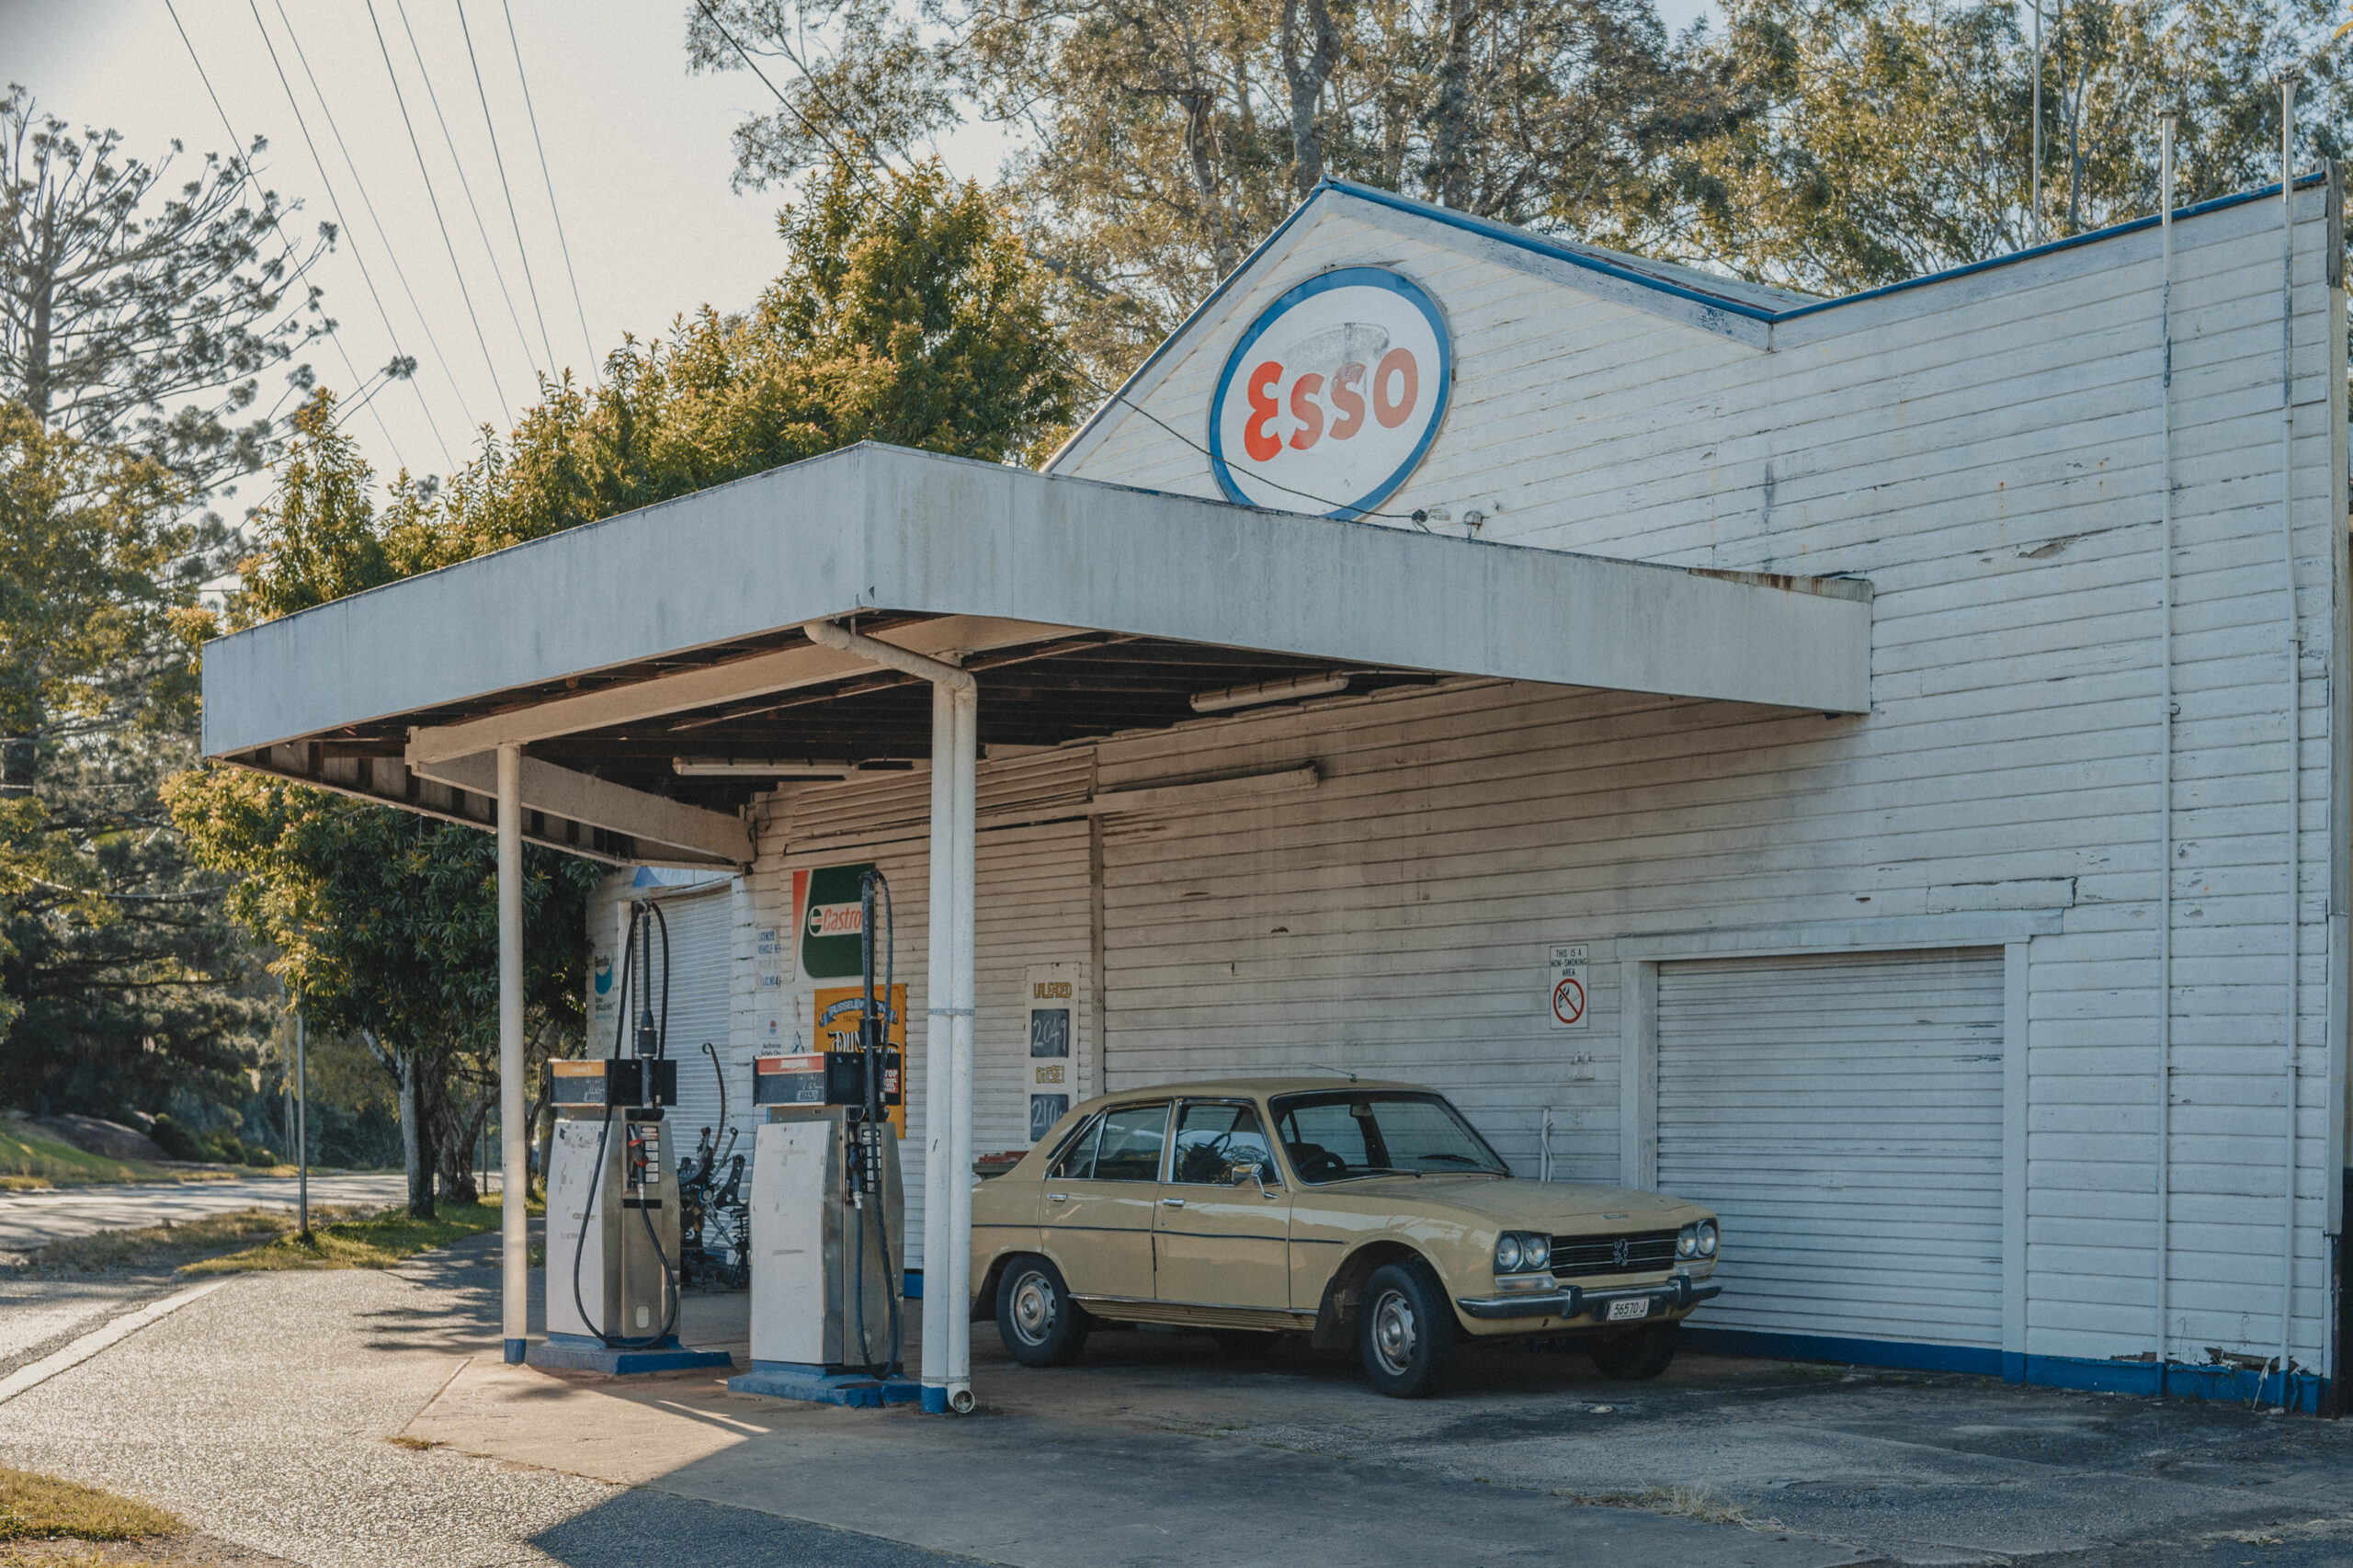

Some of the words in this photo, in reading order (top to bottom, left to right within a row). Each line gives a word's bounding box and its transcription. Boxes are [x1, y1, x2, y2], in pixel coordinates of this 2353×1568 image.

[1244, 347, 1418, 462] ESSO
[823, 906, 862, 932] Castro
[1556, 949, 1567, 958] THIS
[1551, 958, 1587, 968] NON-SMOKING
